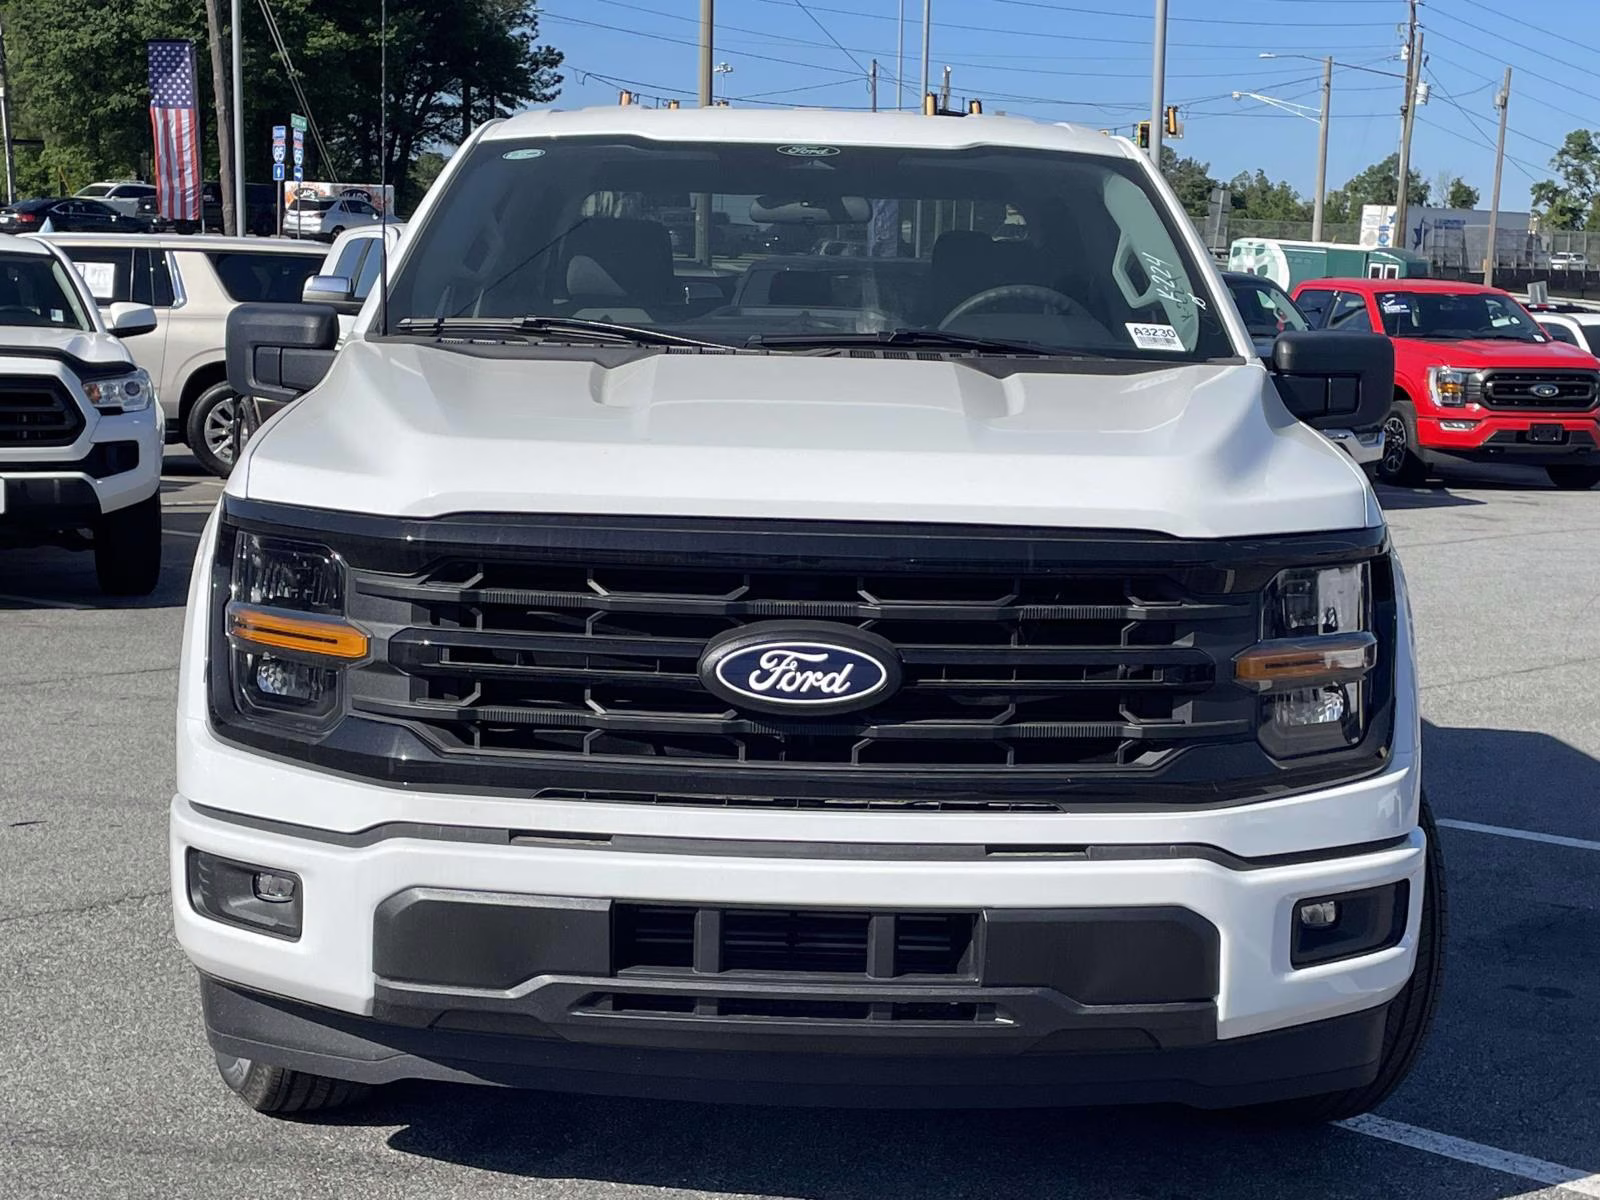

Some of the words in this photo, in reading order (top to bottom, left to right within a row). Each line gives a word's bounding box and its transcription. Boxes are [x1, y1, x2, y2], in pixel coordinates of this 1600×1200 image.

[274, 146, 284, 160] 85
[1133, 327, 1176, 338] A3230
[748, 649, 854, 694] Ford
